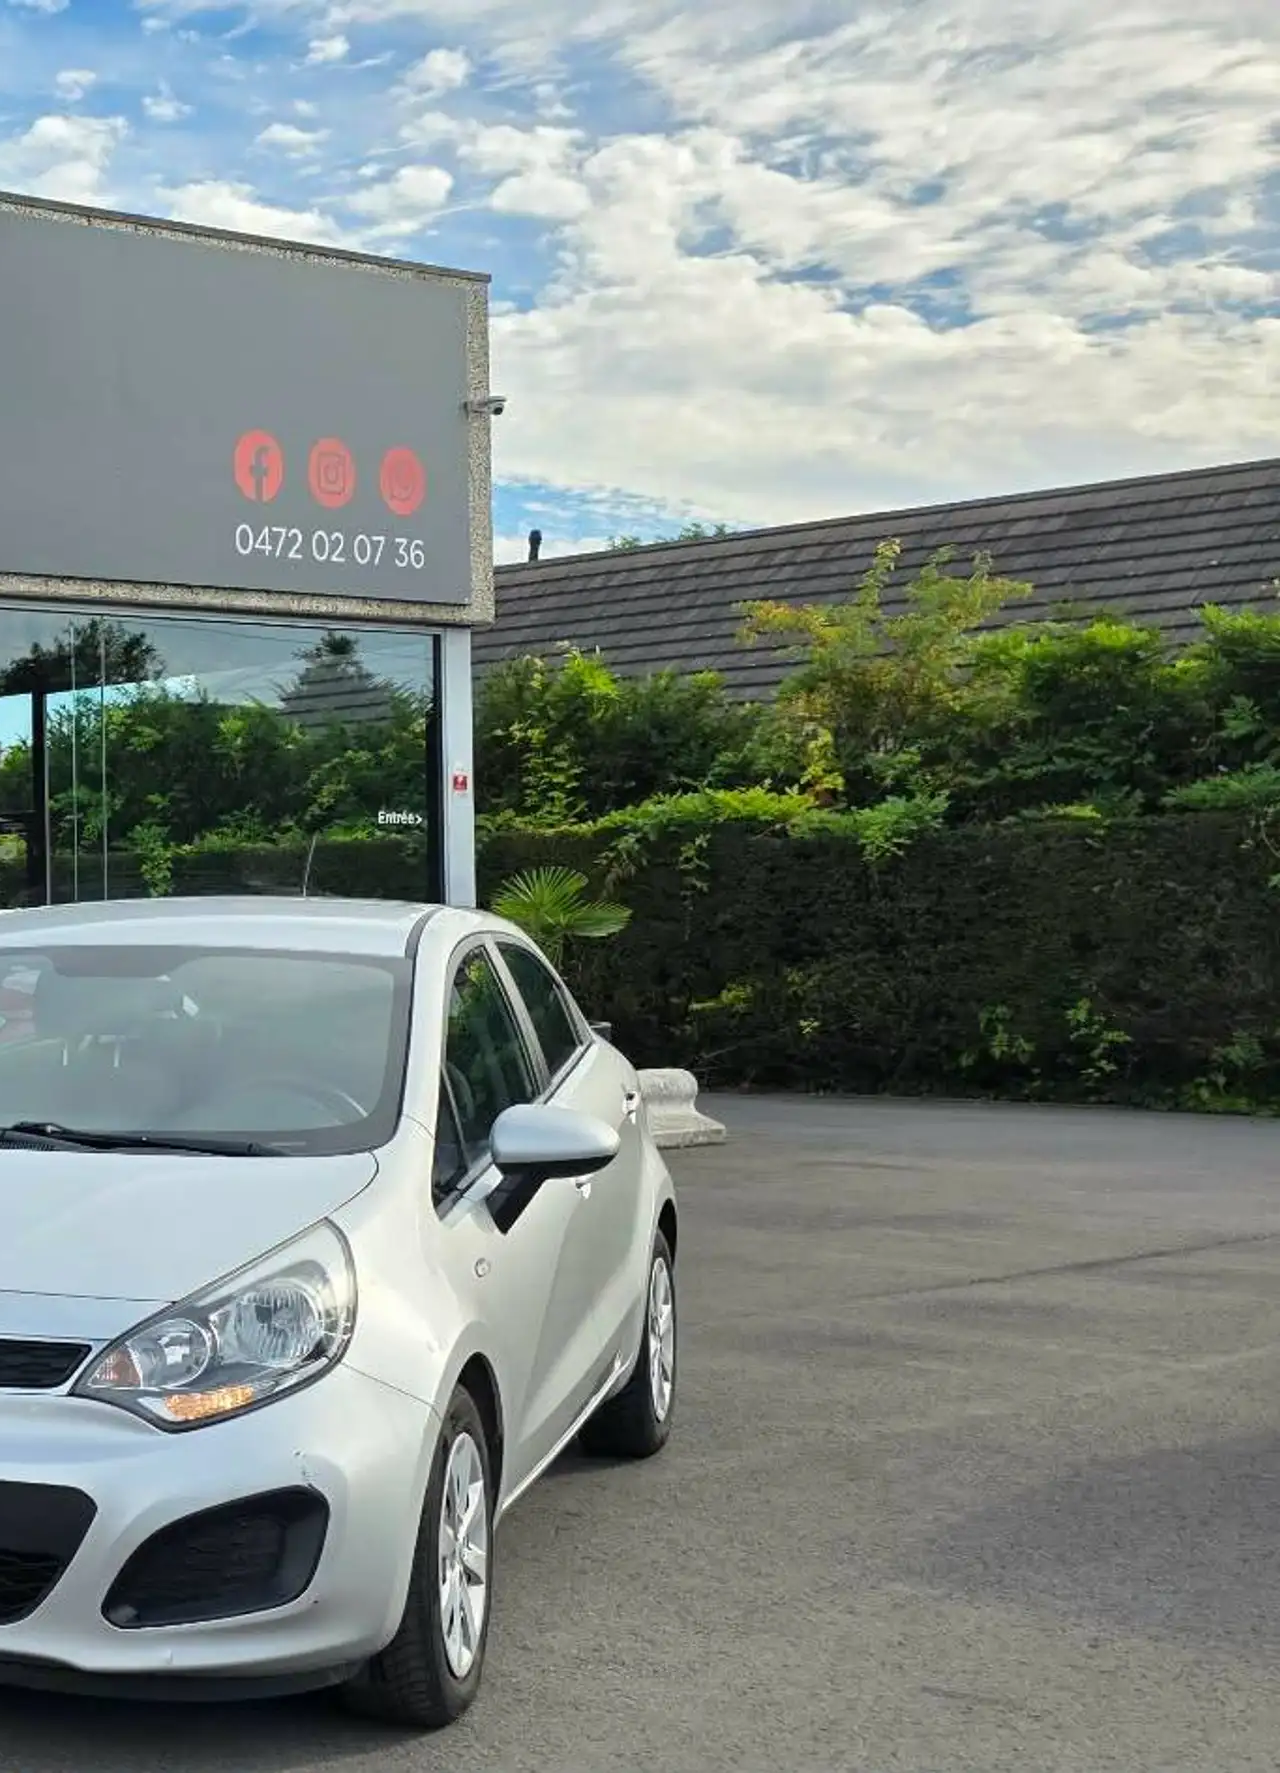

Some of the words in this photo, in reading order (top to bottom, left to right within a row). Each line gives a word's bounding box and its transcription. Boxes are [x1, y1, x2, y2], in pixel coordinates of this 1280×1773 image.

[235, 524, 303, 559] 0472
[312, 530, 345, 562] 02
[353, 534, 385, 566] 07
[395, 537, 425, 569] 36
